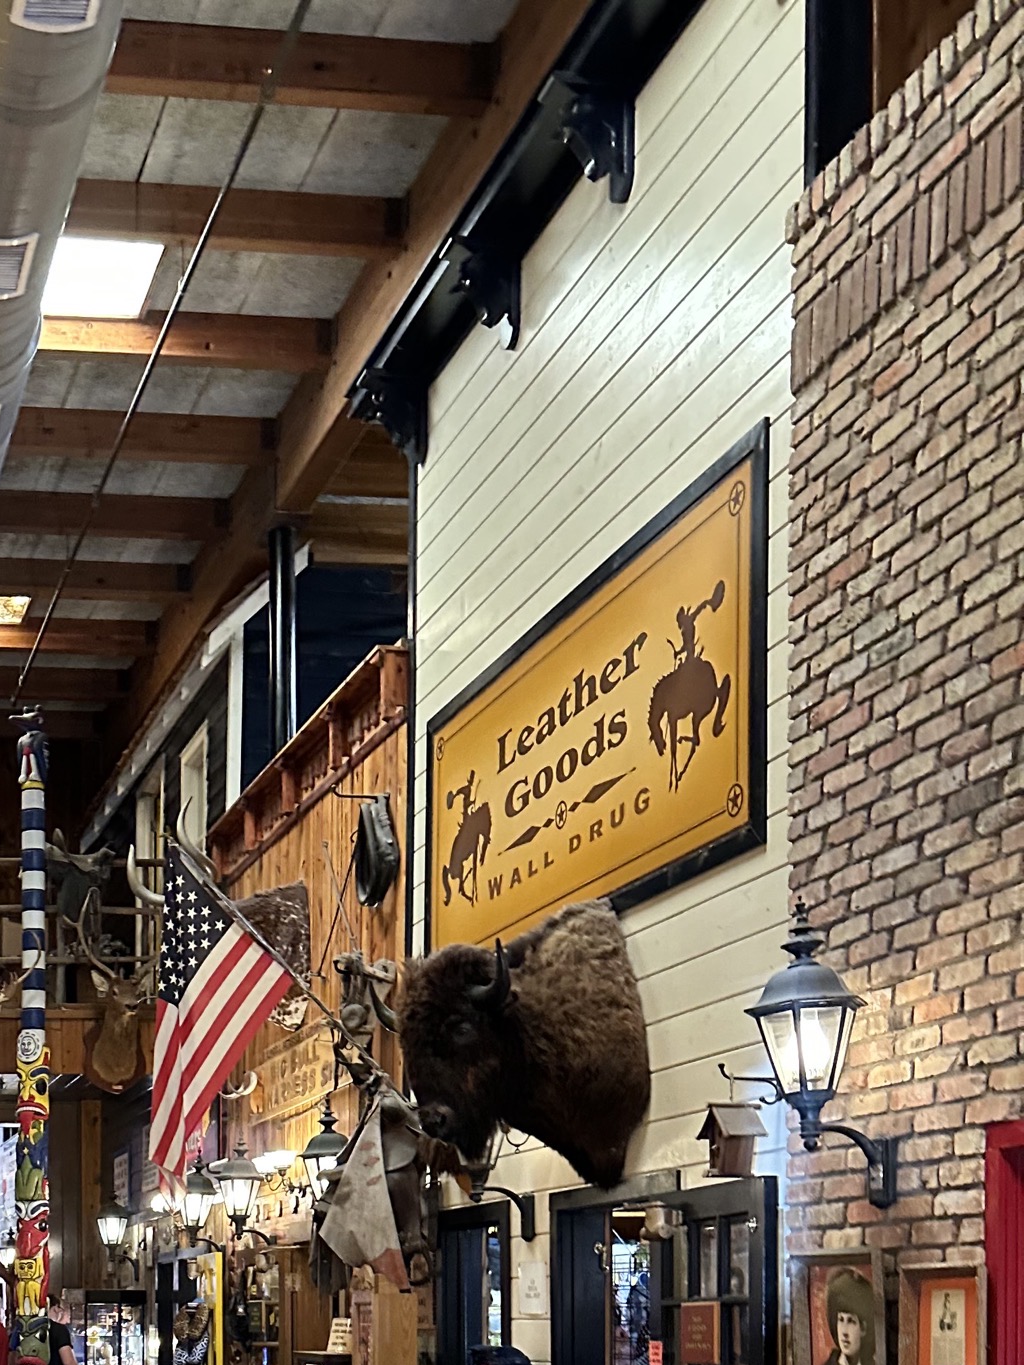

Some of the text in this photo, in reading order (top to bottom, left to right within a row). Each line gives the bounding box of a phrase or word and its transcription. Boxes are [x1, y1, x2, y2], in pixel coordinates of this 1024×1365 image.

[496, 632, 648, 774] Leather
[504, 709, 628, 819] Goods
[486, 787, 652, 900] WALL DRUG
